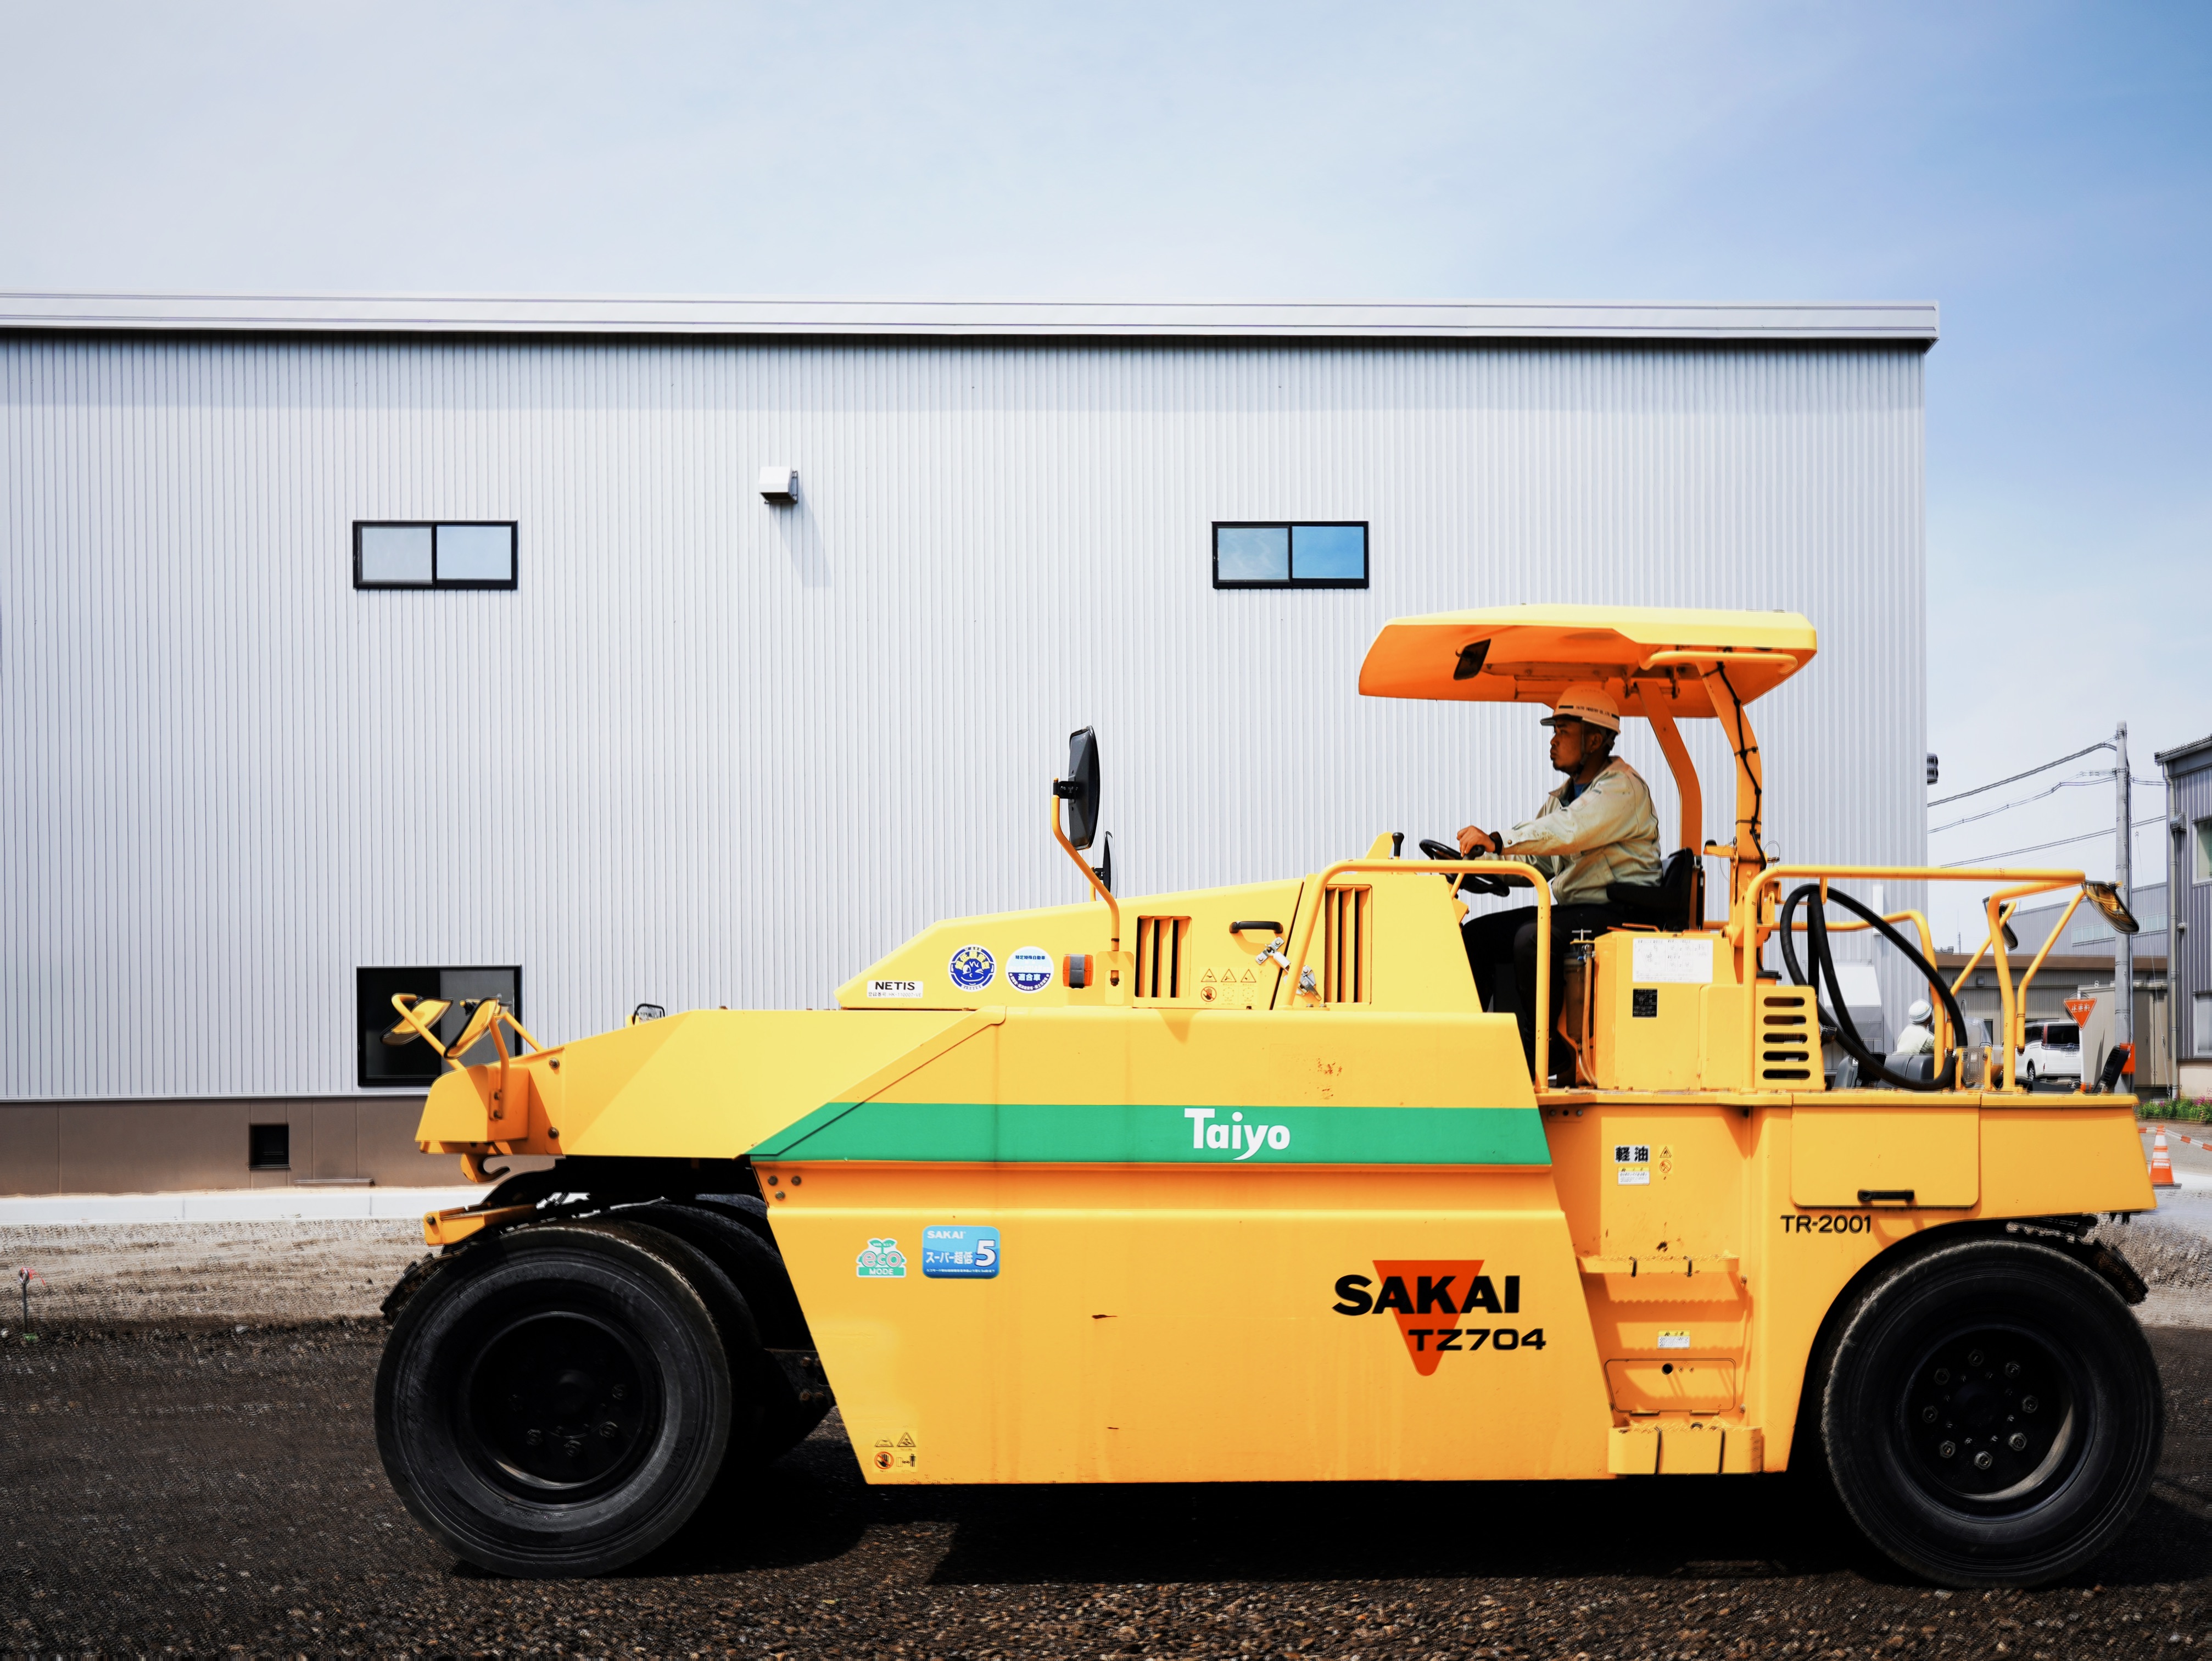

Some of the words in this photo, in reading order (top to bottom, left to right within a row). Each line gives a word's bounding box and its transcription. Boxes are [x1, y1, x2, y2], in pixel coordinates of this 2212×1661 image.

[875, 982, 915, 990] NETIS
[2071, 1003, 2091, 1013] 止まれ
[1184, 1108, 1291, 1161] Taiyo
[1780, 1214, 1871, 1234] TR-2001
[927, 1230, 964, 1239] SAKAI
[862, 1252, 901, 1267] eco
[1332, 1274, 1520, 1316] SAKAI
[1408, 1328, 1546, 1351] TZ704
